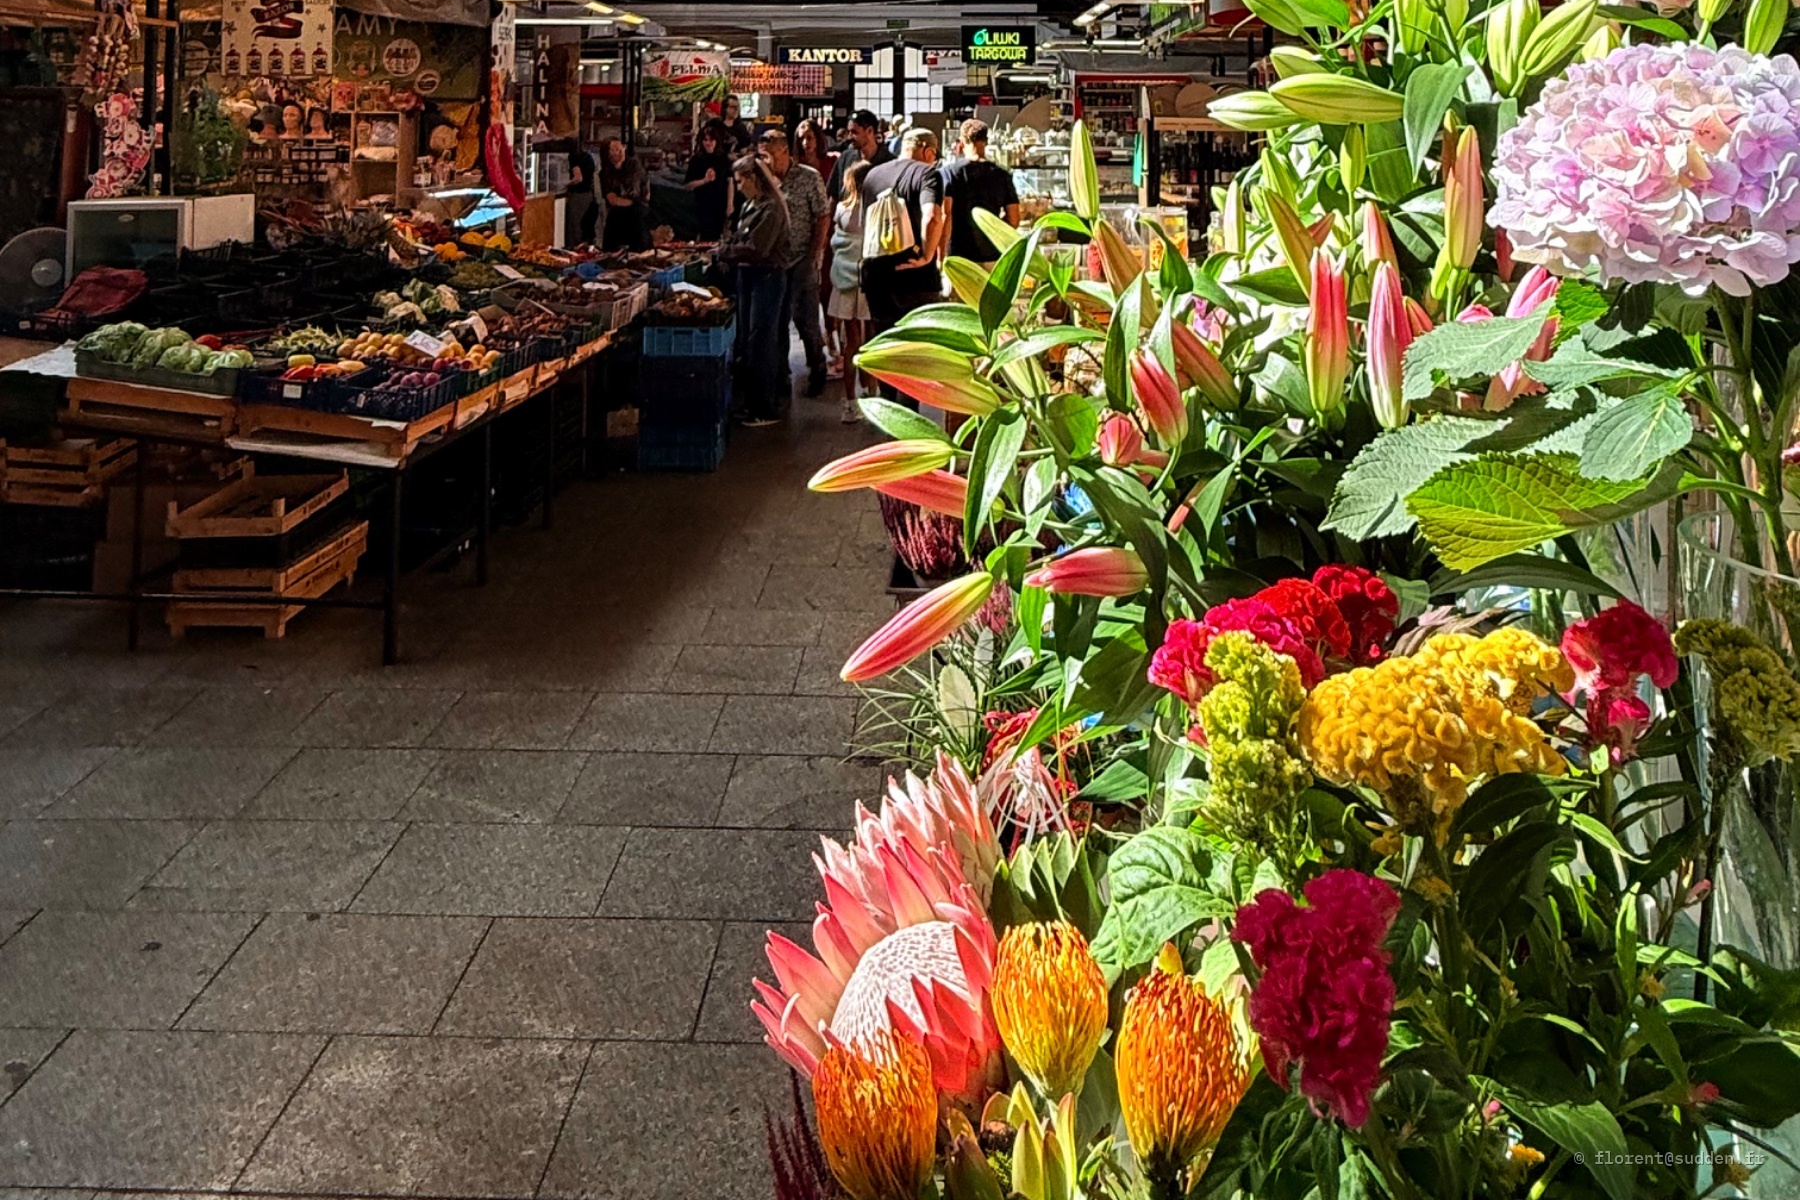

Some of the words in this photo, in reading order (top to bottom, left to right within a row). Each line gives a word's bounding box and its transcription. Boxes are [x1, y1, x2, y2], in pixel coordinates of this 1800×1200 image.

[788, 48, 863, 63] KANTOR
[968, 46, 1028, 60] TARGOWA
[536, 34, 551, 135] HALINA
